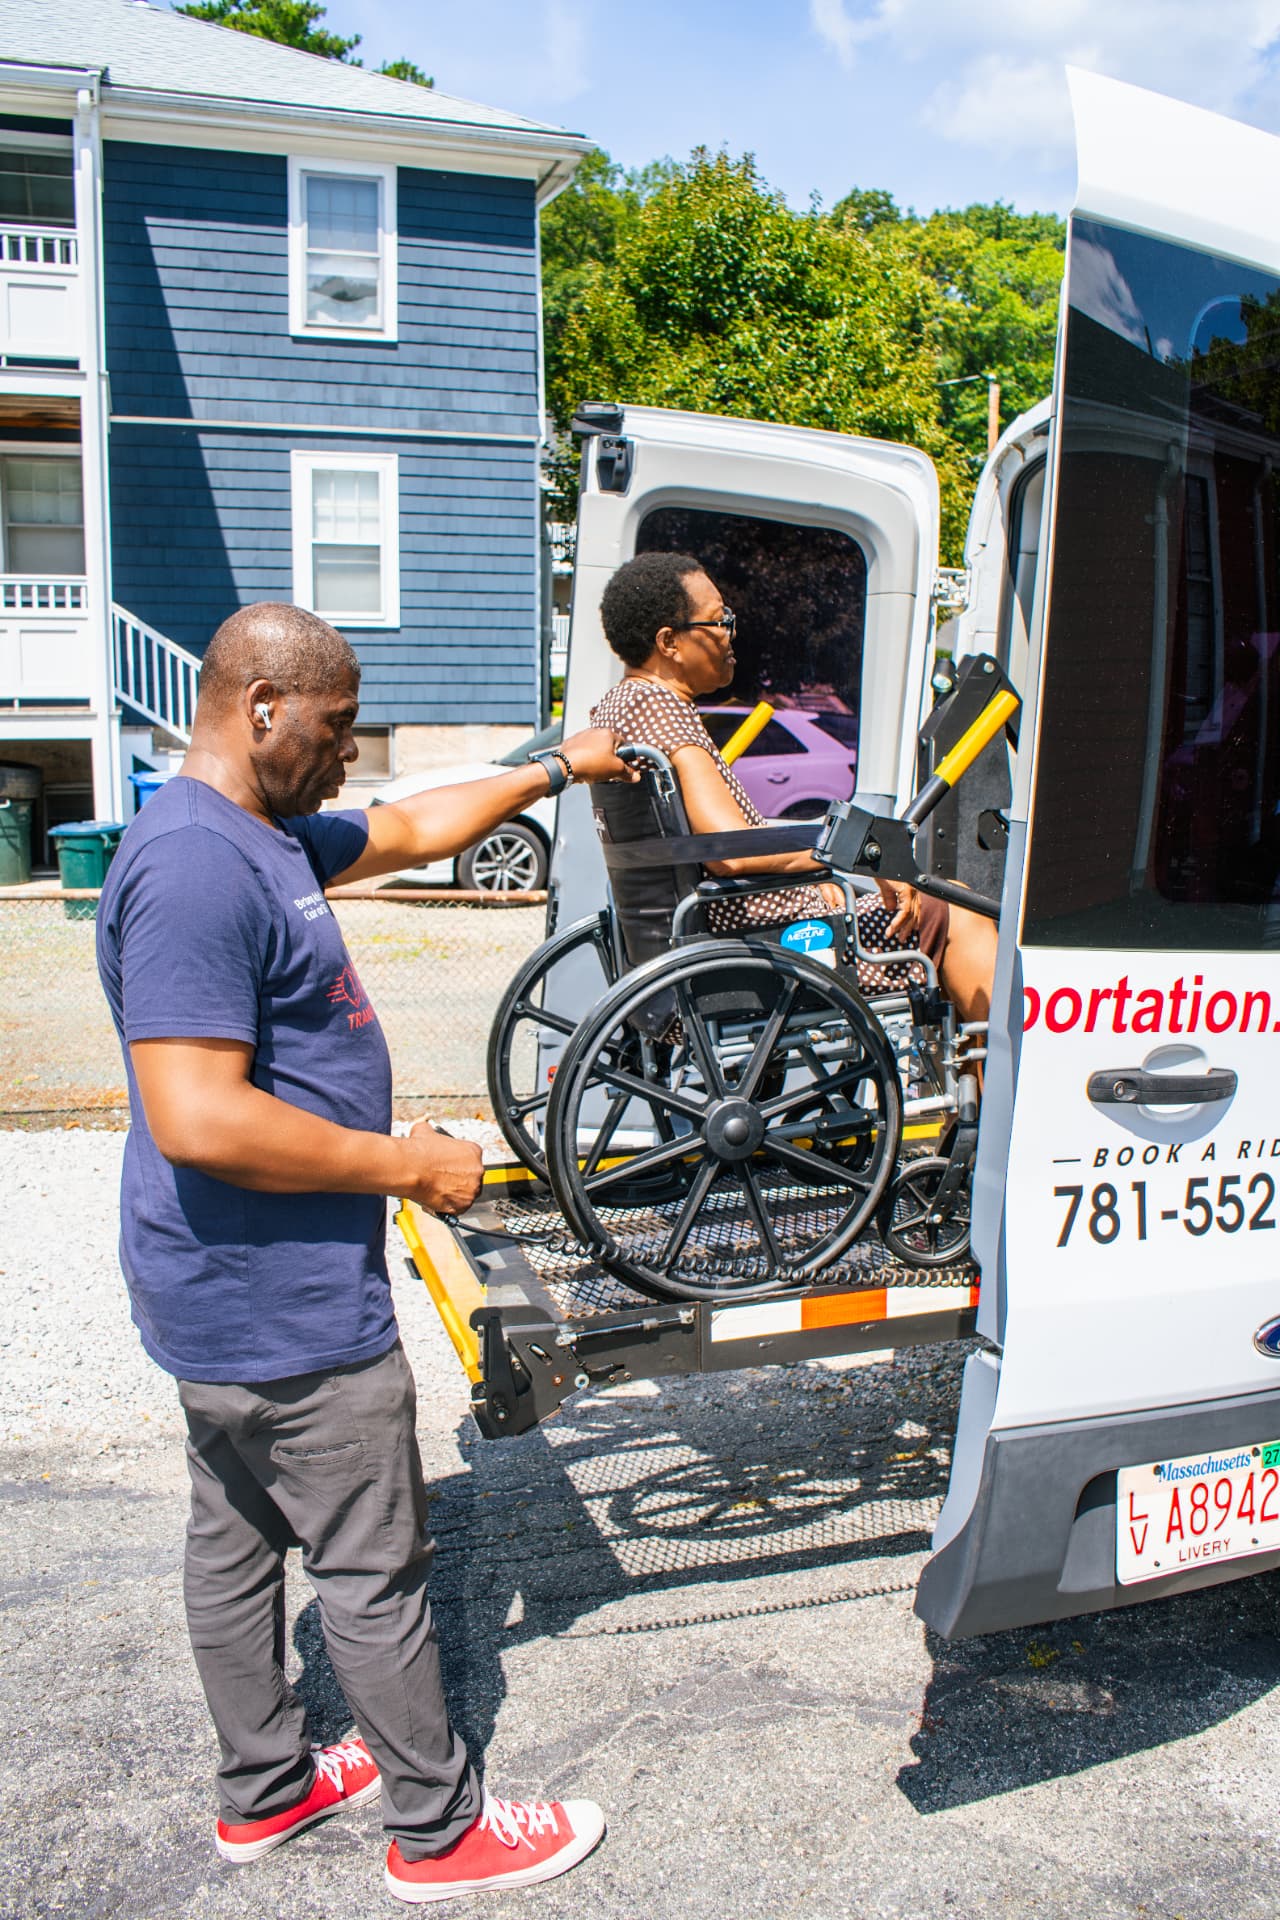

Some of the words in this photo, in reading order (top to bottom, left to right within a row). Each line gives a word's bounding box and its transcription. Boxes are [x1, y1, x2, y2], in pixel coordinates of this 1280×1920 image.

[787, 927, 827, 942] MEDLINE
[1093, 1143, 1184, 1168] BOOK
[1201, 1142, 1216, 1162] A
[1053, 1172, 1276, 1248] 781-552
[1159, 1453, 1251, 1482] Massachusetts
[1264, 1449, 1280, 1465] 27
[1165, 1468, 1280, 1544] A8942
[1178, 1538, 1232, 1563] LIVERY
